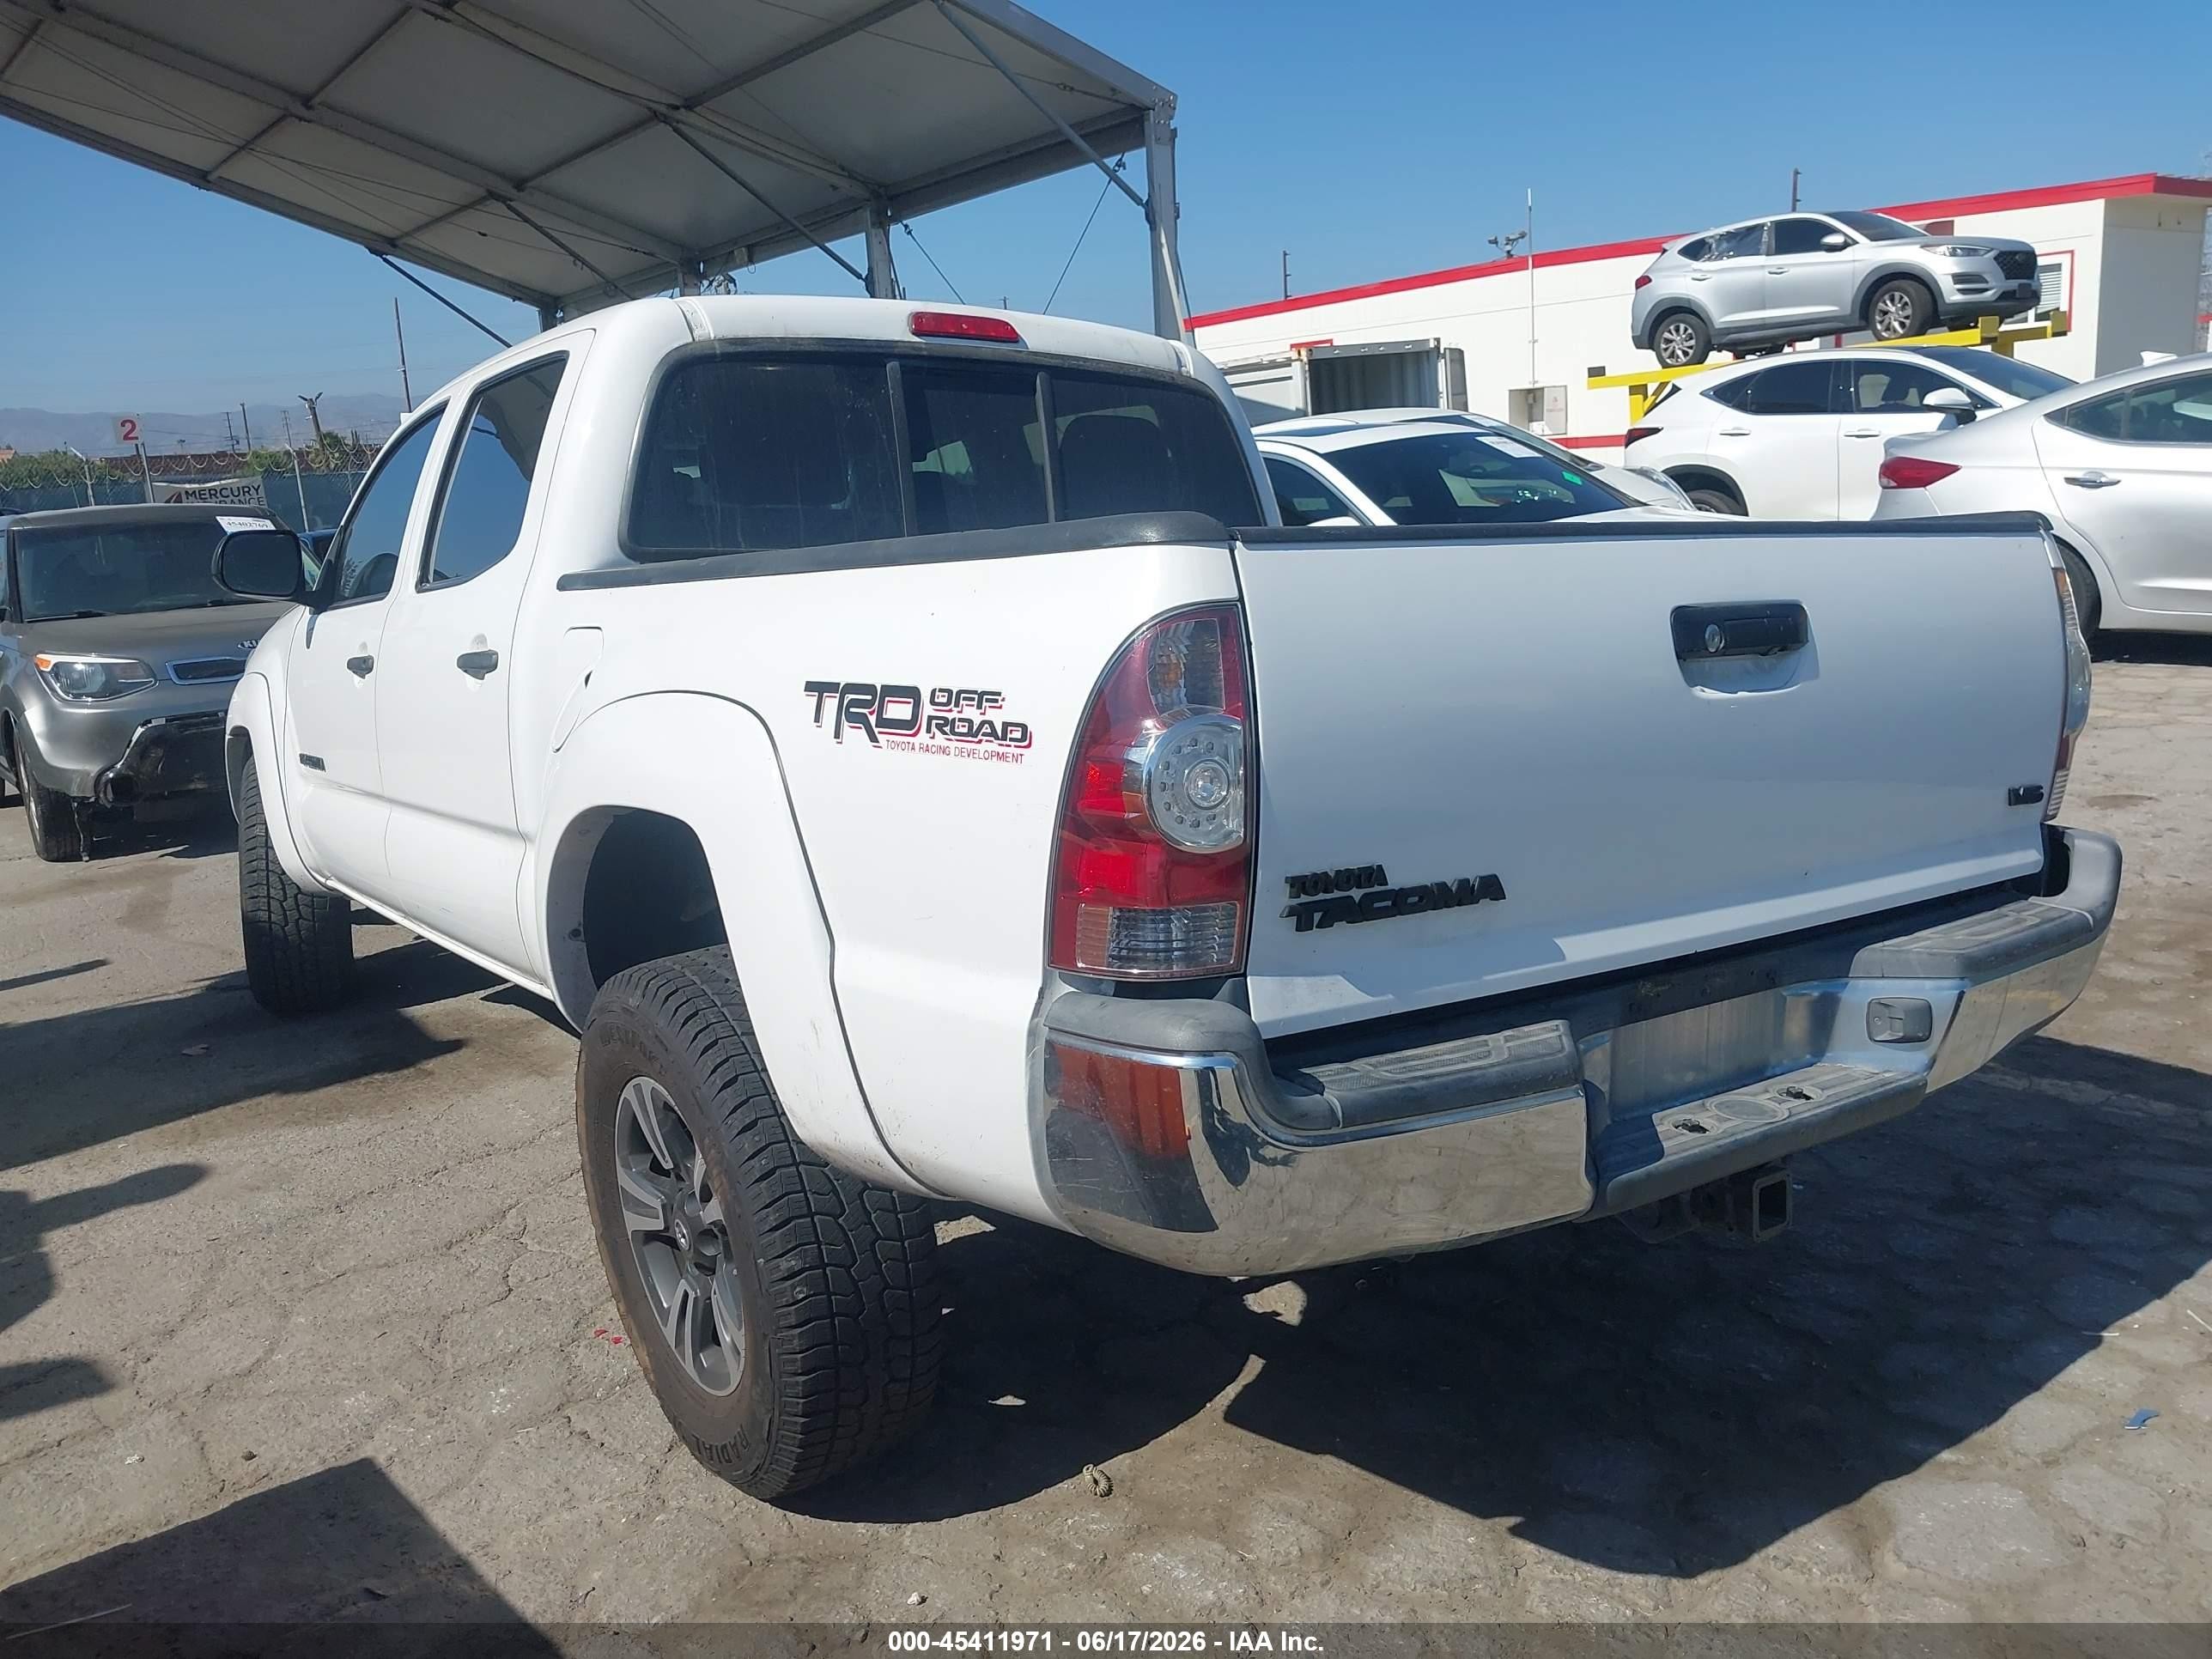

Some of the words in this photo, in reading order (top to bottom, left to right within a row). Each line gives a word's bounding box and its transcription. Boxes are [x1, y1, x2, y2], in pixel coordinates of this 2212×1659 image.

[120, 419, 139, 441] 2
[185, 484, 261, 500] MERCURY
[804, 681, 923, 746] TRD
[928, 687, 1004, 714] OFF
[926, 714, 1031, 747] ROAD
[885, 738, 916, 752] TOYOTA
[918, 743, 951, 757] RACING
[953, 746, 1025, 764] DEVELOPMENT
[1285, 864, 1389, 899] TOYOTA
[1279, 873, 1507, 932] TACOMA
